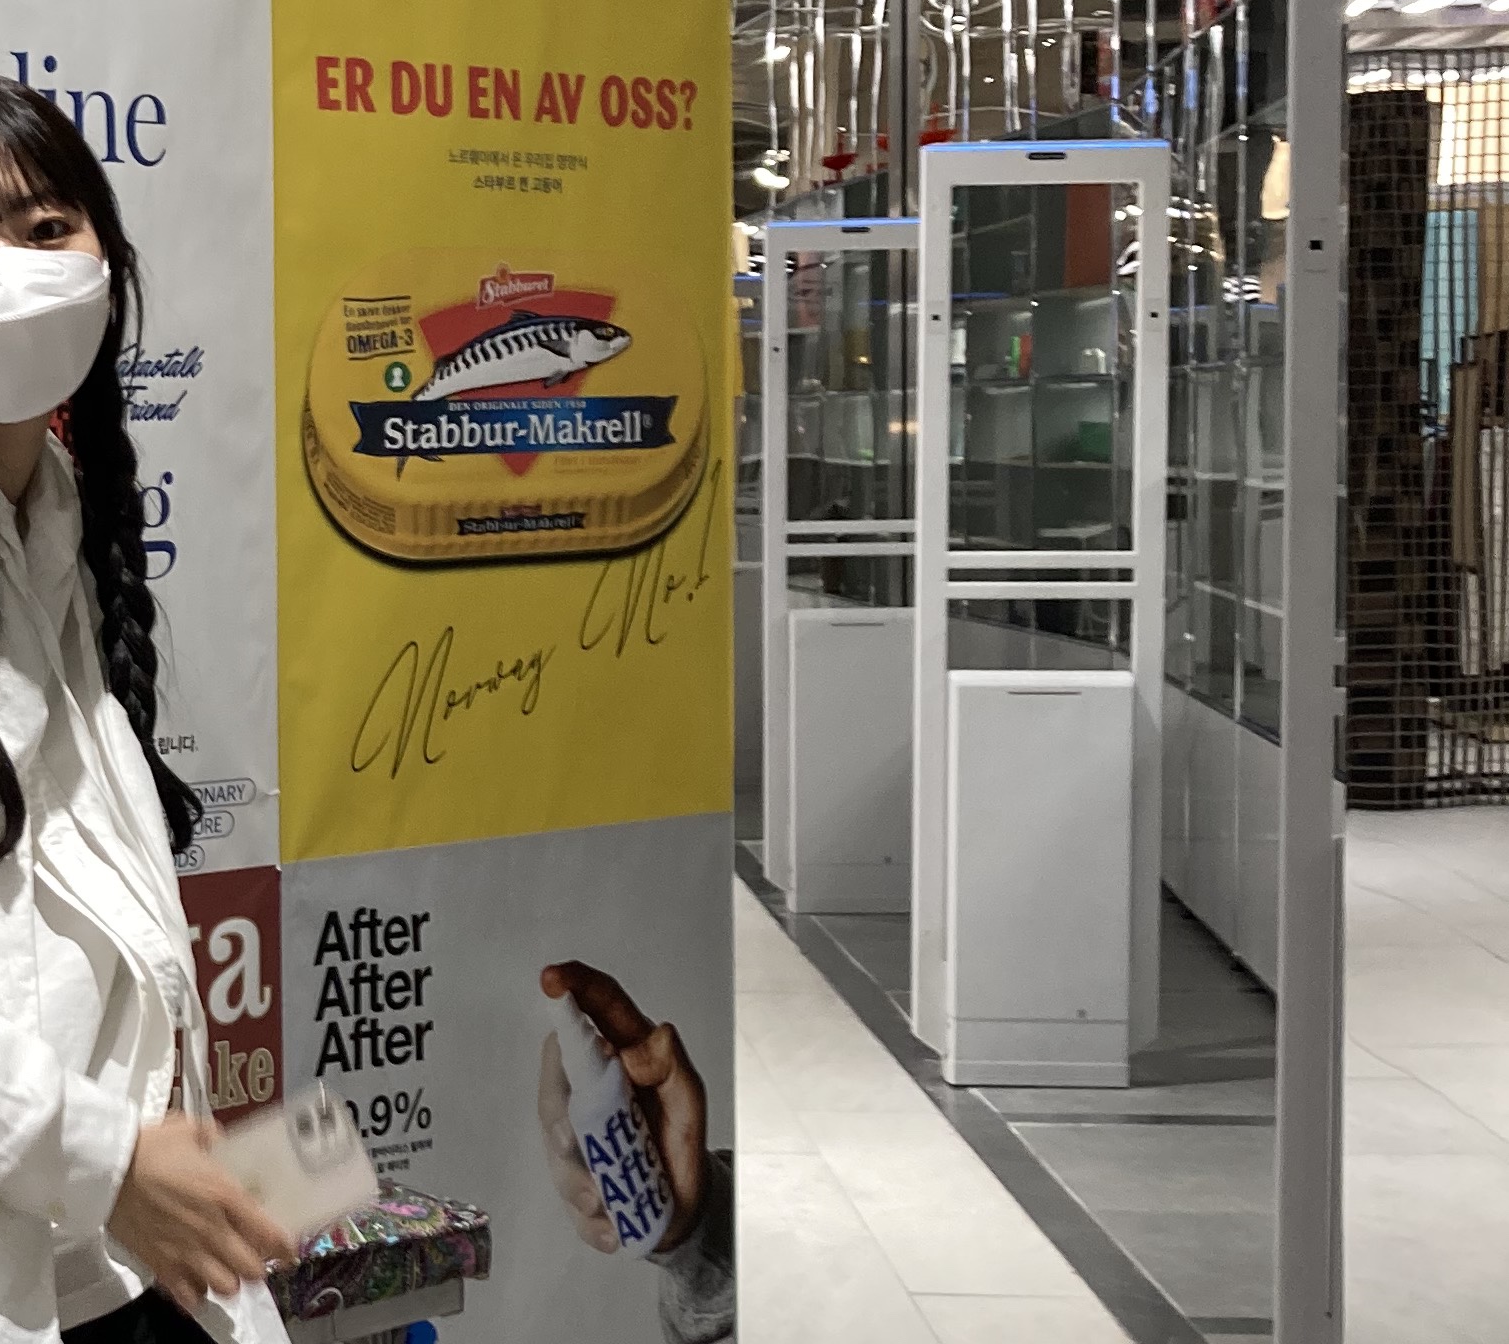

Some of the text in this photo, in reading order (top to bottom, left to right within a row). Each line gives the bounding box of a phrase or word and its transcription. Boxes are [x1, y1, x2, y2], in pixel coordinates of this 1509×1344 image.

[315, 55, 698, 132] ER DU EN AV OSS?
[347, 328, 415, 355] OMEGA-3
[383, 410, 644, 452] Stabbur-Makrell
[314, 906, 430, 967] After
[315, 962, 433, 1021] After
[315, 1017, 434, 1076] After
